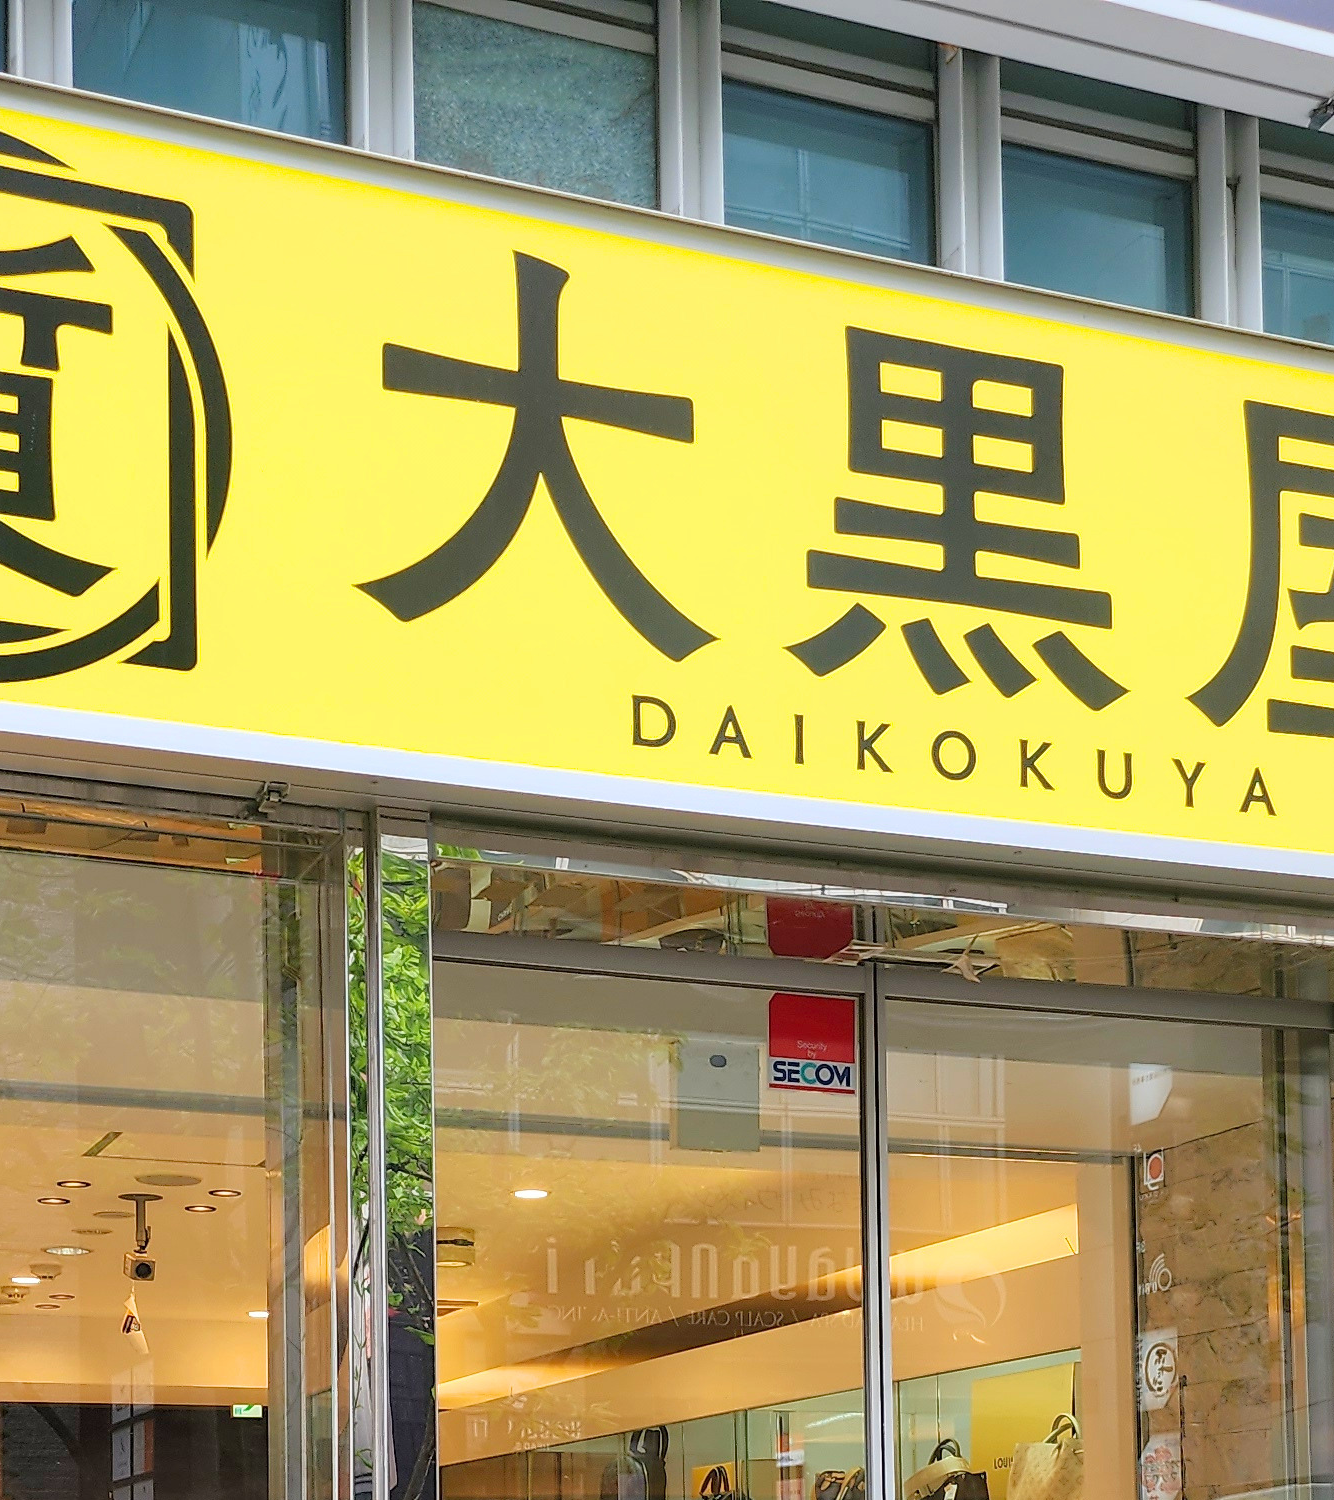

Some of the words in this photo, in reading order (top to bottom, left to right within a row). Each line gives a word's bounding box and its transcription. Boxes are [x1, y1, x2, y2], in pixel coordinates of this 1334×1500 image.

[631, 693, 1277, 818] DAIKOKUYA
[797, 1040, 828, 1051] Security
[807, 1050, 817, 1059] by
[773, 1061, 851, 1087] SECOM
